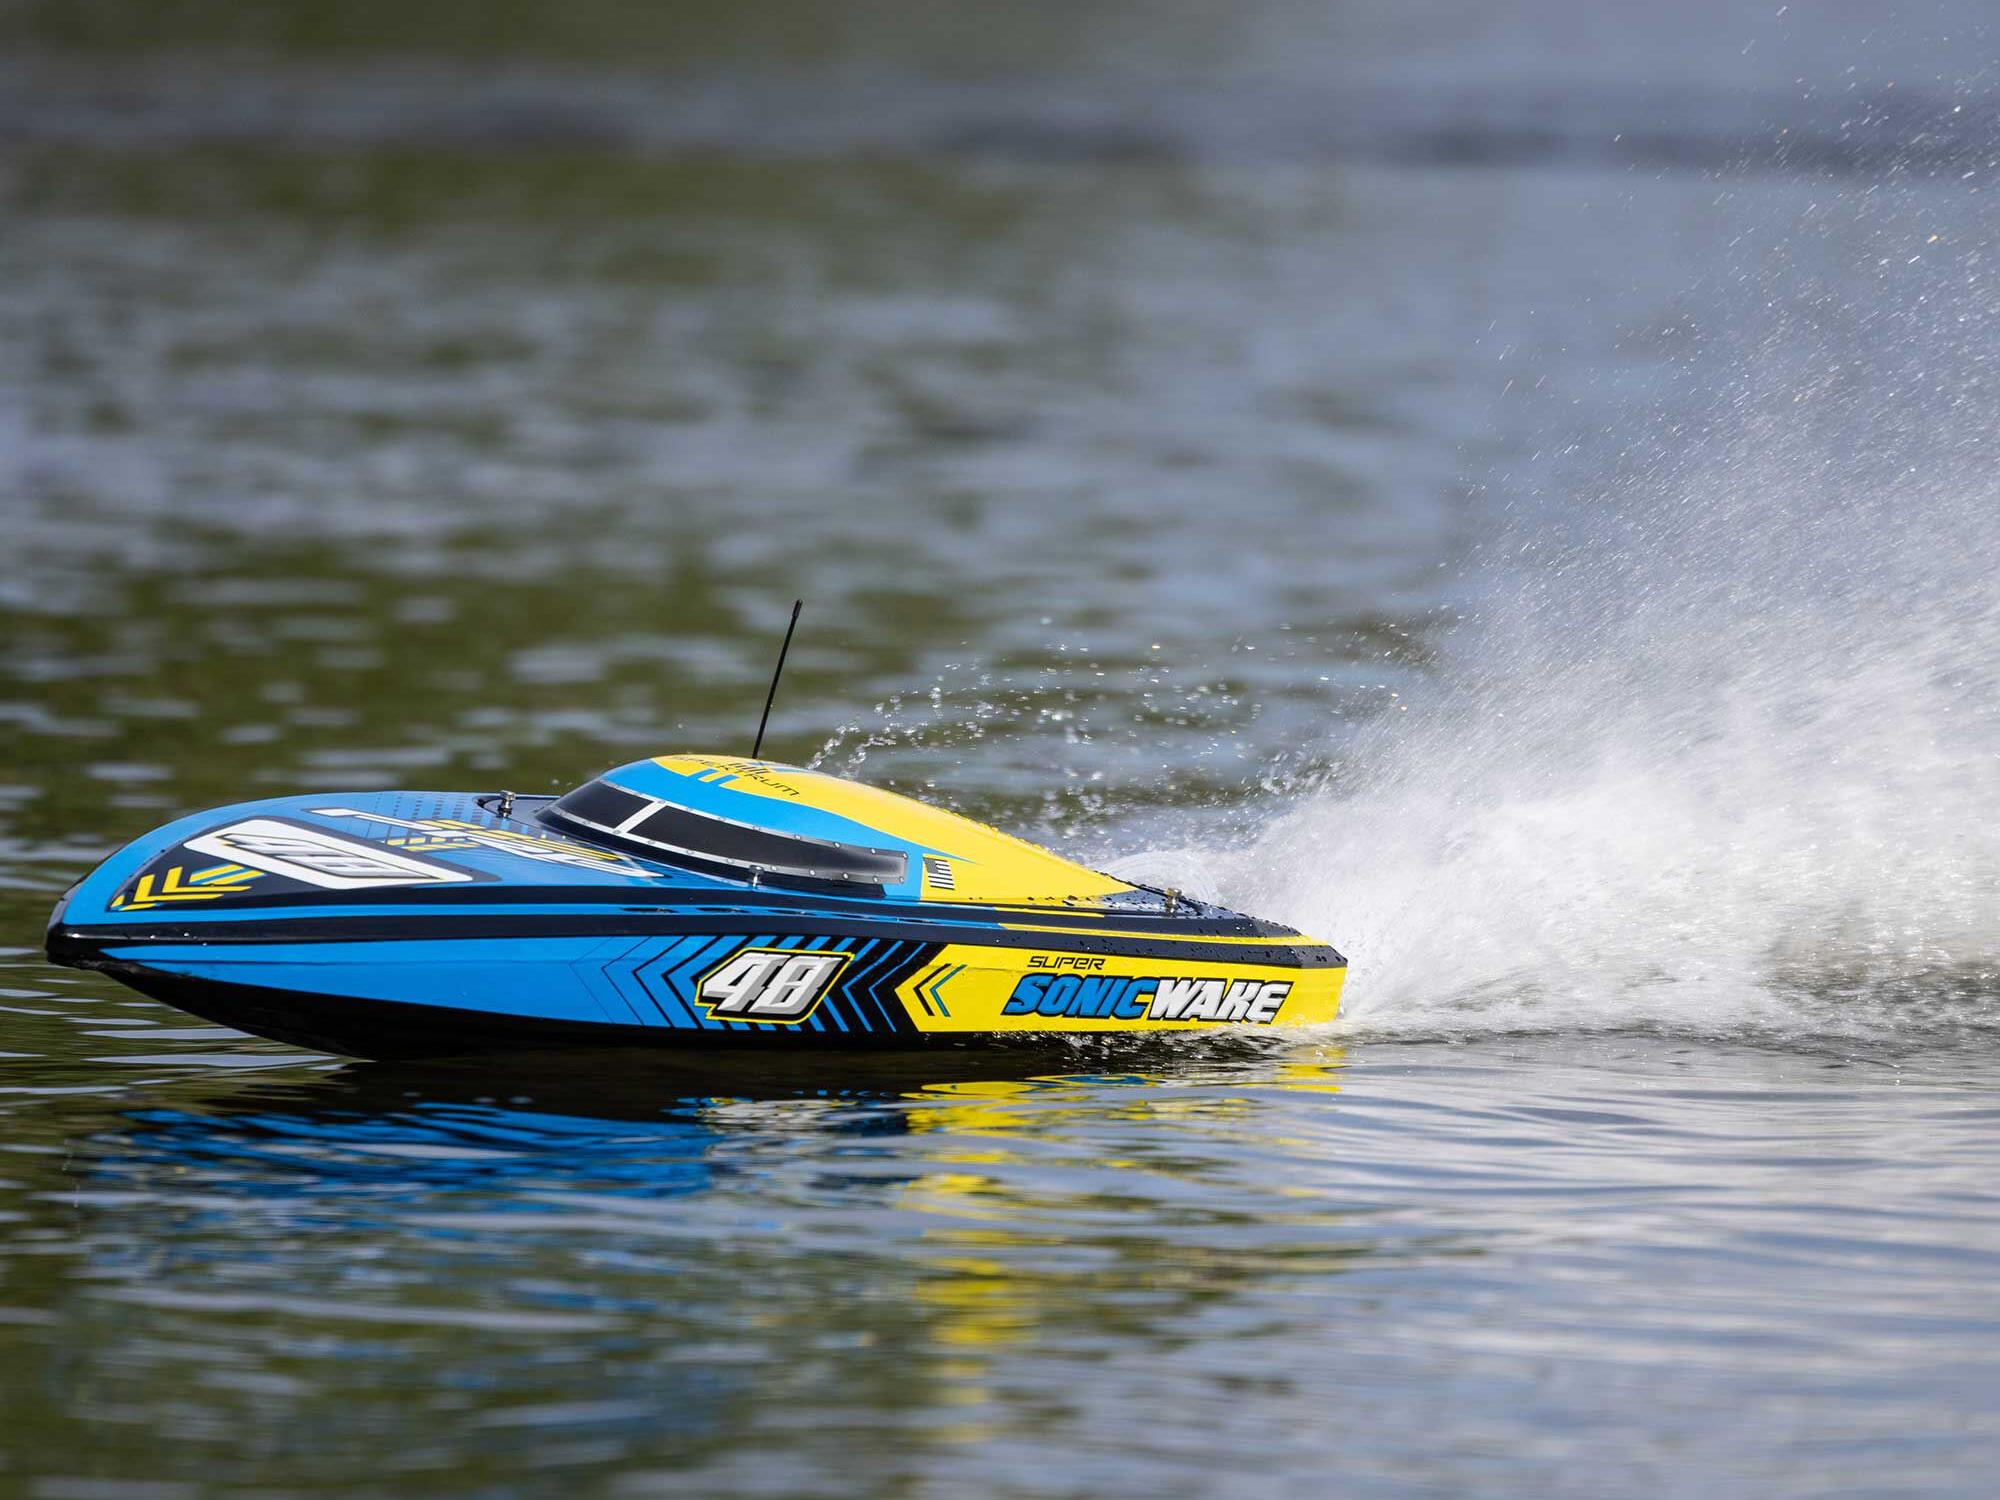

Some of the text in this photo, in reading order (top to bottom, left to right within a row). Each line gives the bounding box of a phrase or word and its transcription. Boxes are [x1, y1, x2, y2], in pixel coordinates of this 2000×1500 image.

[702, 951, 844, 1016] 48
[1027, 955, 1107, 971] SUPER
[1000, 972, 1295, 1025] SONICWAKE
